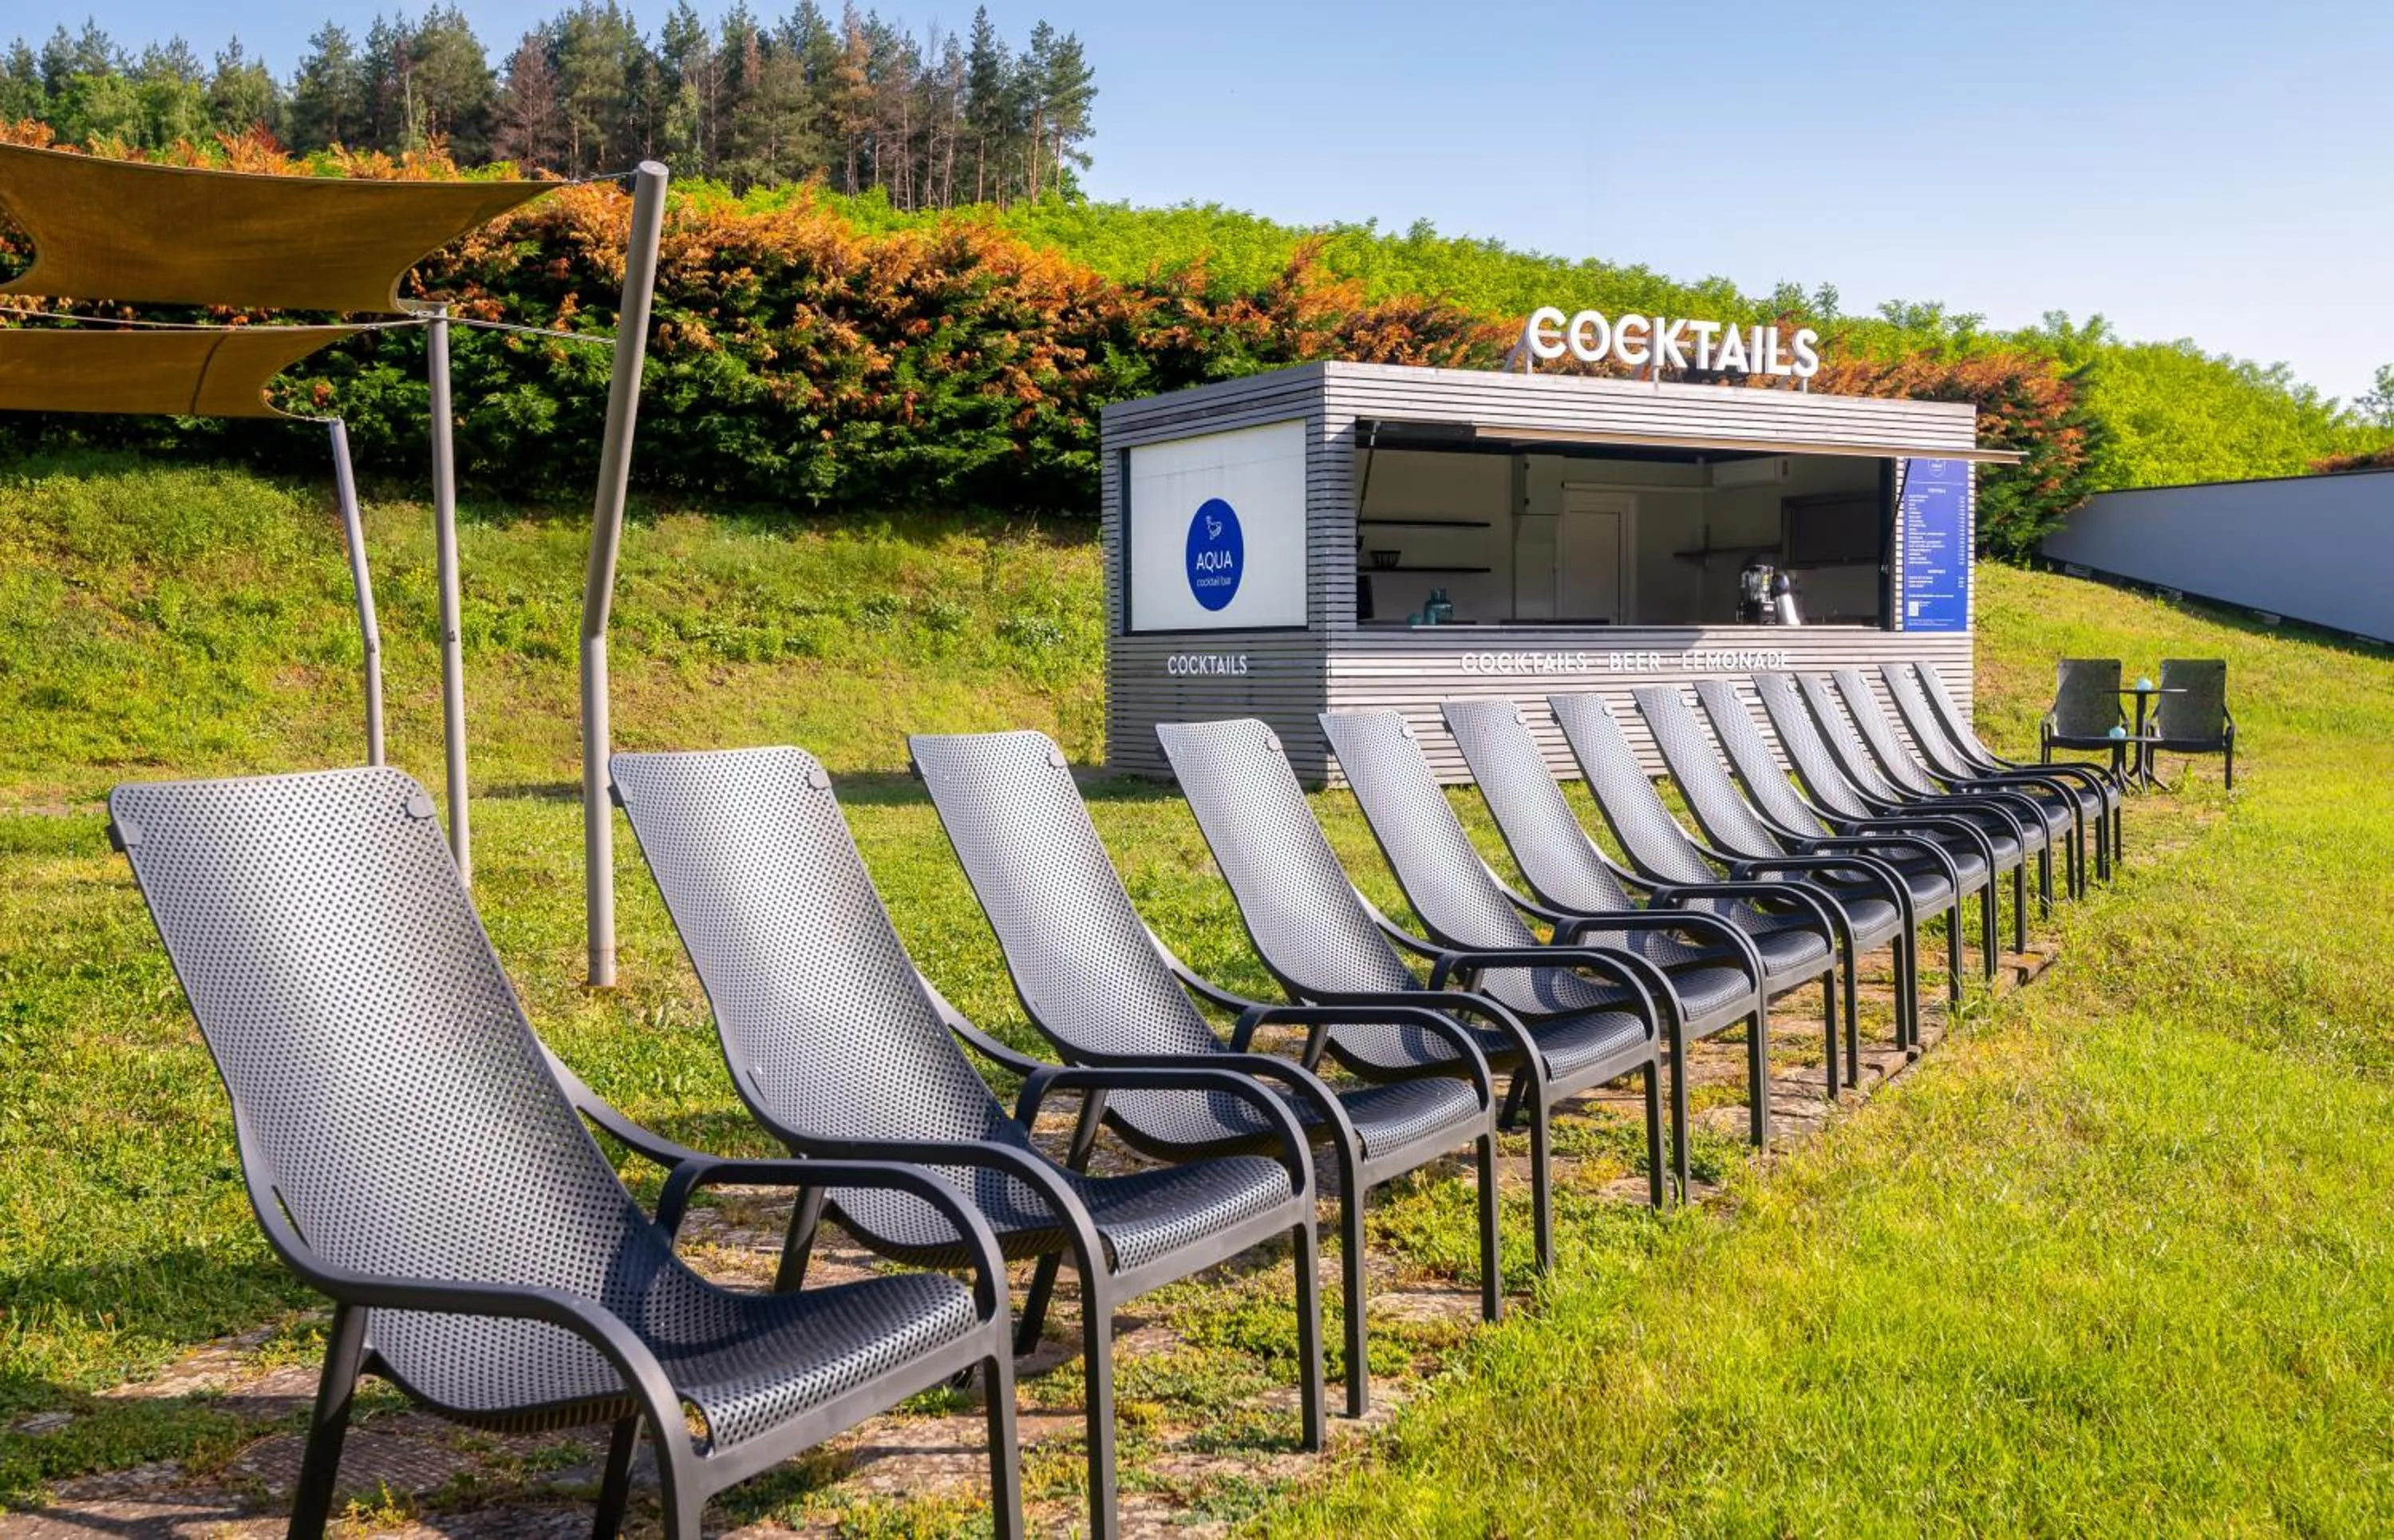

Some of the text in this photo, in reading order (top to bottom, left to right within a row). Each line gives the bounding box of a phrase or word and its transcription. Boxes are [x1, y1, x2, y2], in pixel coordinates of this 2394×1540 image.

[1527, 306, 1819, 377] COCKTAILS
[1196, 549, 1233, 573] AQUA
[1167, 654, 1248, 675] COCKTAILS
[1461, 650, 1792, 674] COCKTAILS BEER LEMONADE
